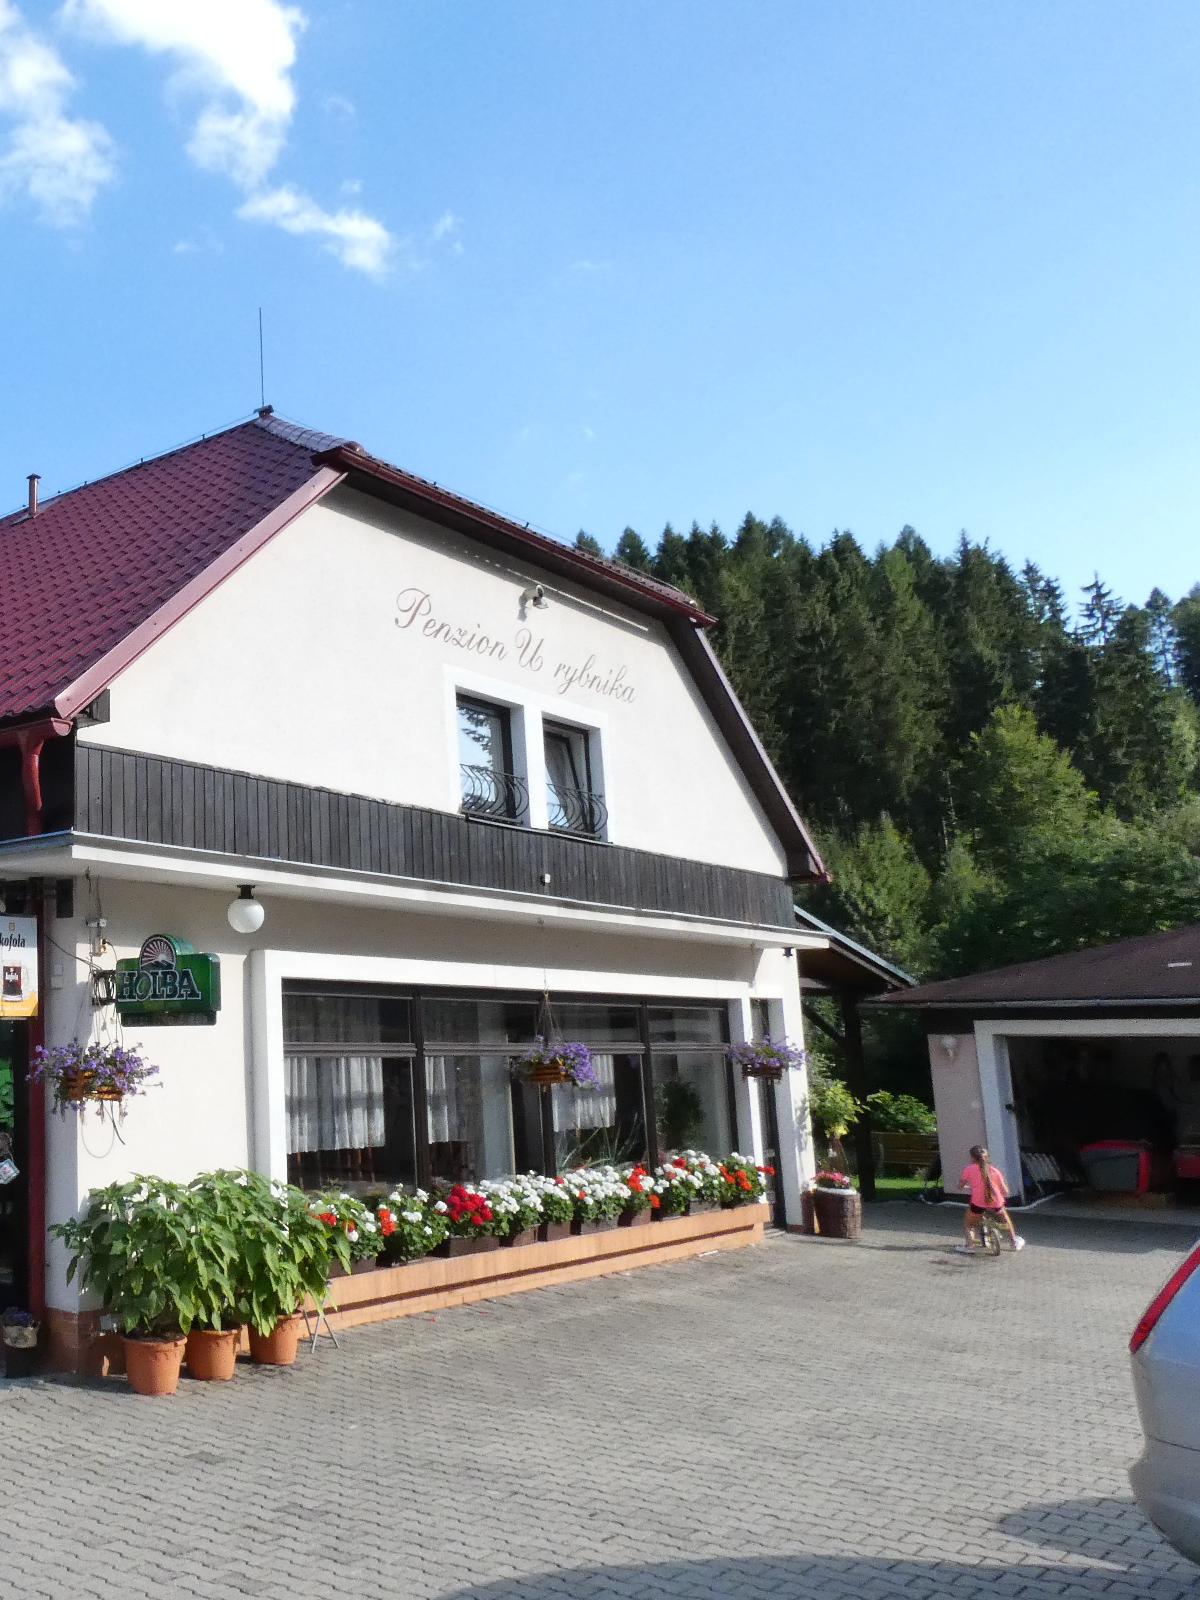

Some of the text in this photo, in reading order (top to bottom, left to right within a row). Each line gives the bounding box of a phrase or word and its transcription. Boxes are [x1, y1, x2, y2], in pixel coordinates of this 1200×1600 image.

[395, 588, 508, 661] Penzion
[515, 628, 545, 672] U
[0, 932, 26, 951] kofola
[117, 968, 202, 1002] HOLBA
